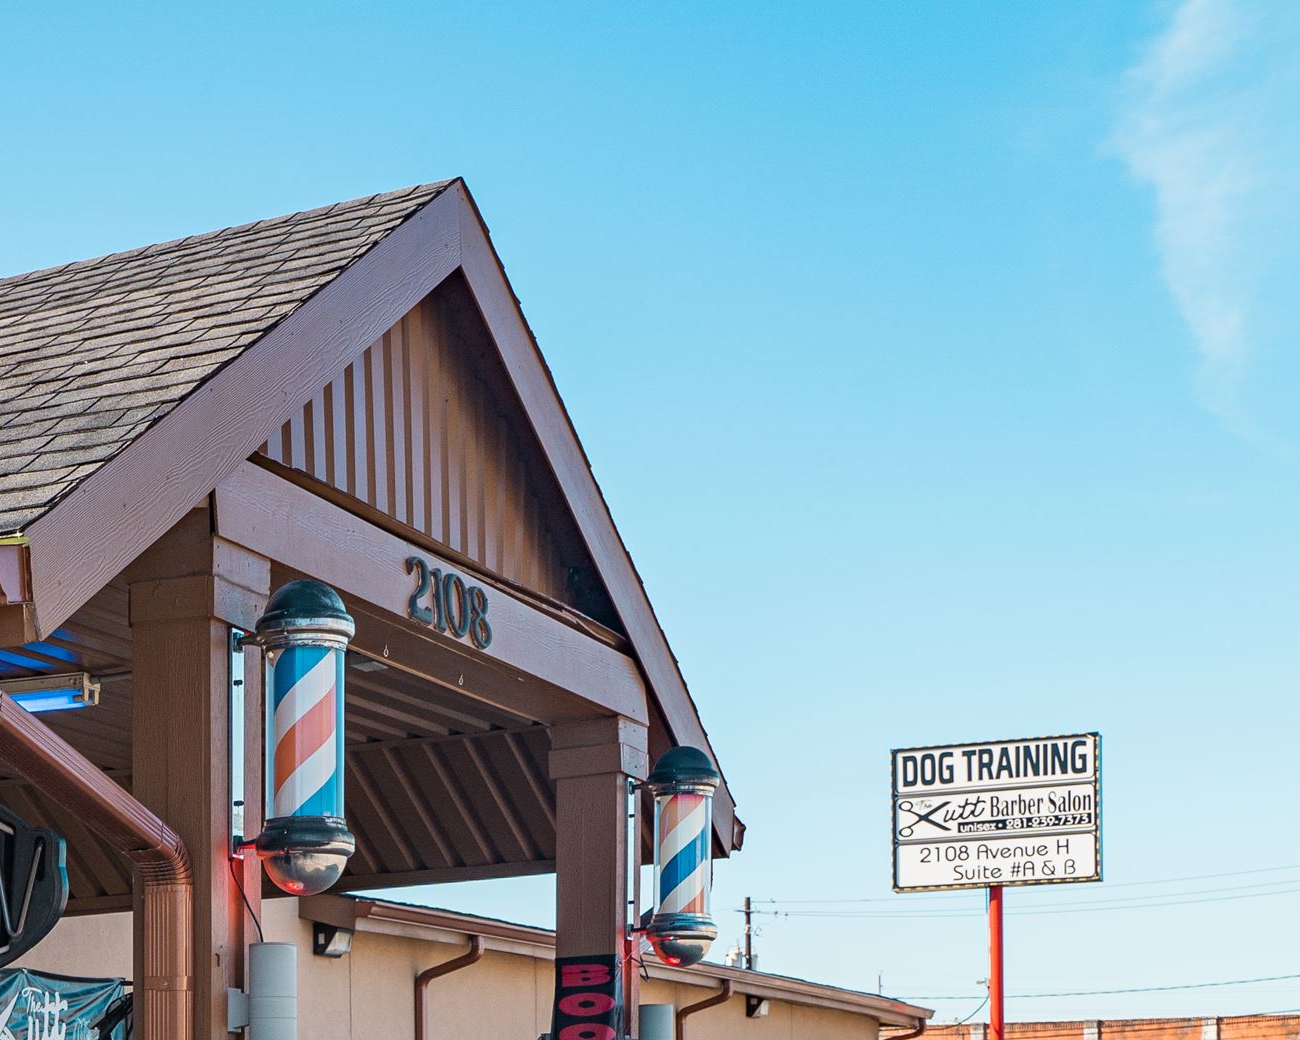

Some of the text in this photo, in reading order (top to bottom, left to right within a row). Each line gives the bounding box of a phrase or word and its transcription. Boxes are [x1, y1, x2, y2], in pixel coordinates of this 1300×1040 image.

[405, 556, 492, 650] 2108
[902, 740, 1087, 787] DOG TRAINING
[990, 794, 1044, 817] Barber
[1047, 790, 1092, 814] Salon
[959, 813, 1089, 833] unisex 281-239-7373
[919, 838, 1069, 864] 2108 Avenue H
[953, 861, 1002, 881] Suite
[1041, 860, 1056, 876] &
[1064, 858, 1076, 875] B
